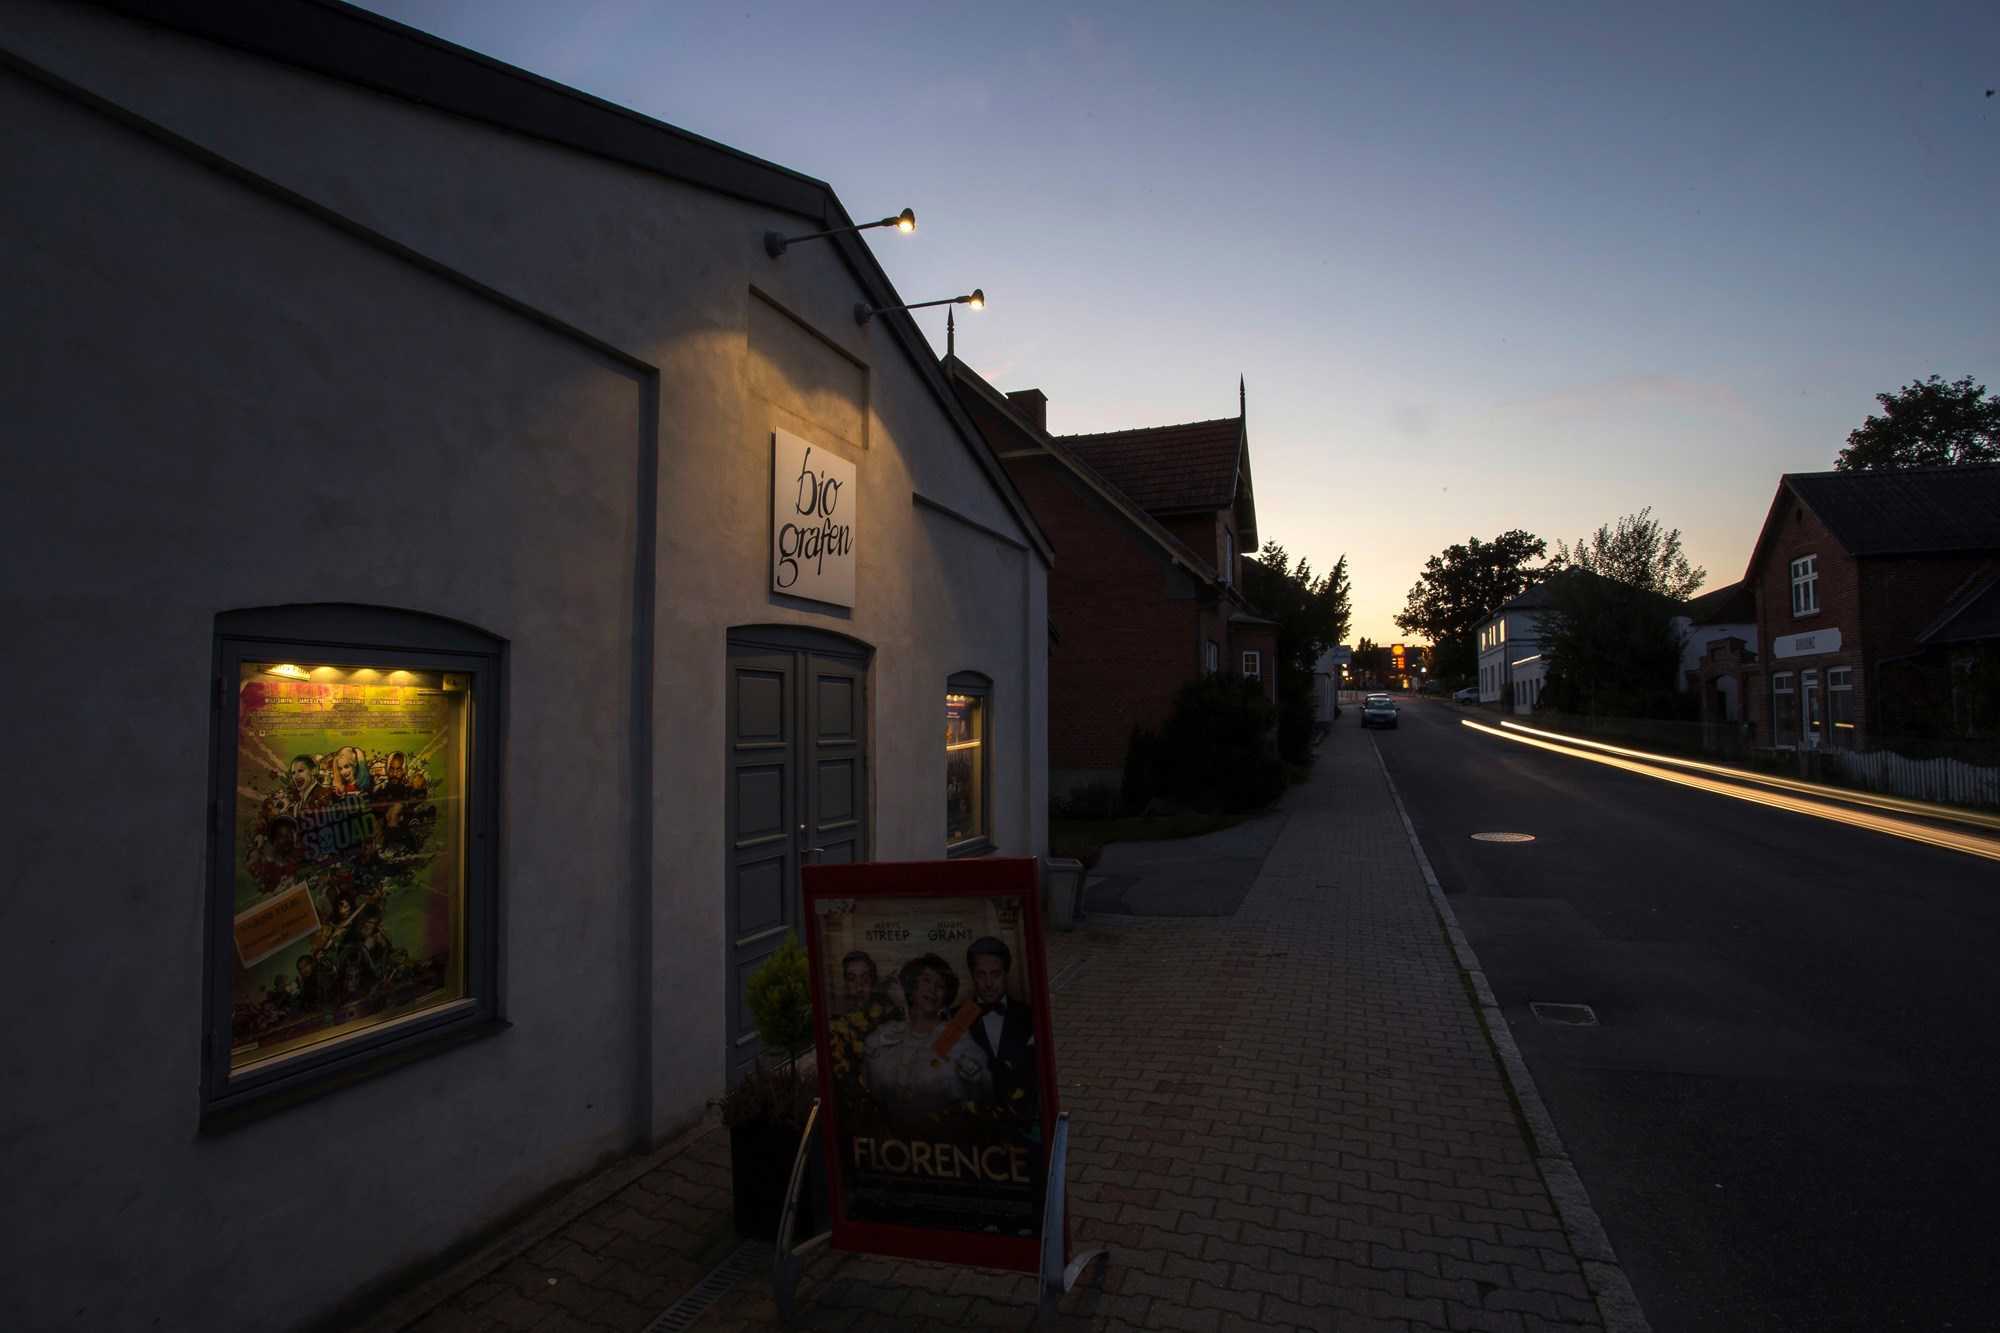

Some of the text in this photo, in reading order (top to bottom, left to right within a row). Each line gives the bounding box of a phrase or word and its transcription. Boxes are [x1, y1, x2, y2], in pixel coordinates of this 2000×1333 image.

[796, 447, 844, 518] bio
[777, 517, 854, 588] grafen
[303, 812, 376, 860] SQUAD
[865, 929, 910, 942] STREEP
[854, 1136, 1030, 1183] FLORENCE
